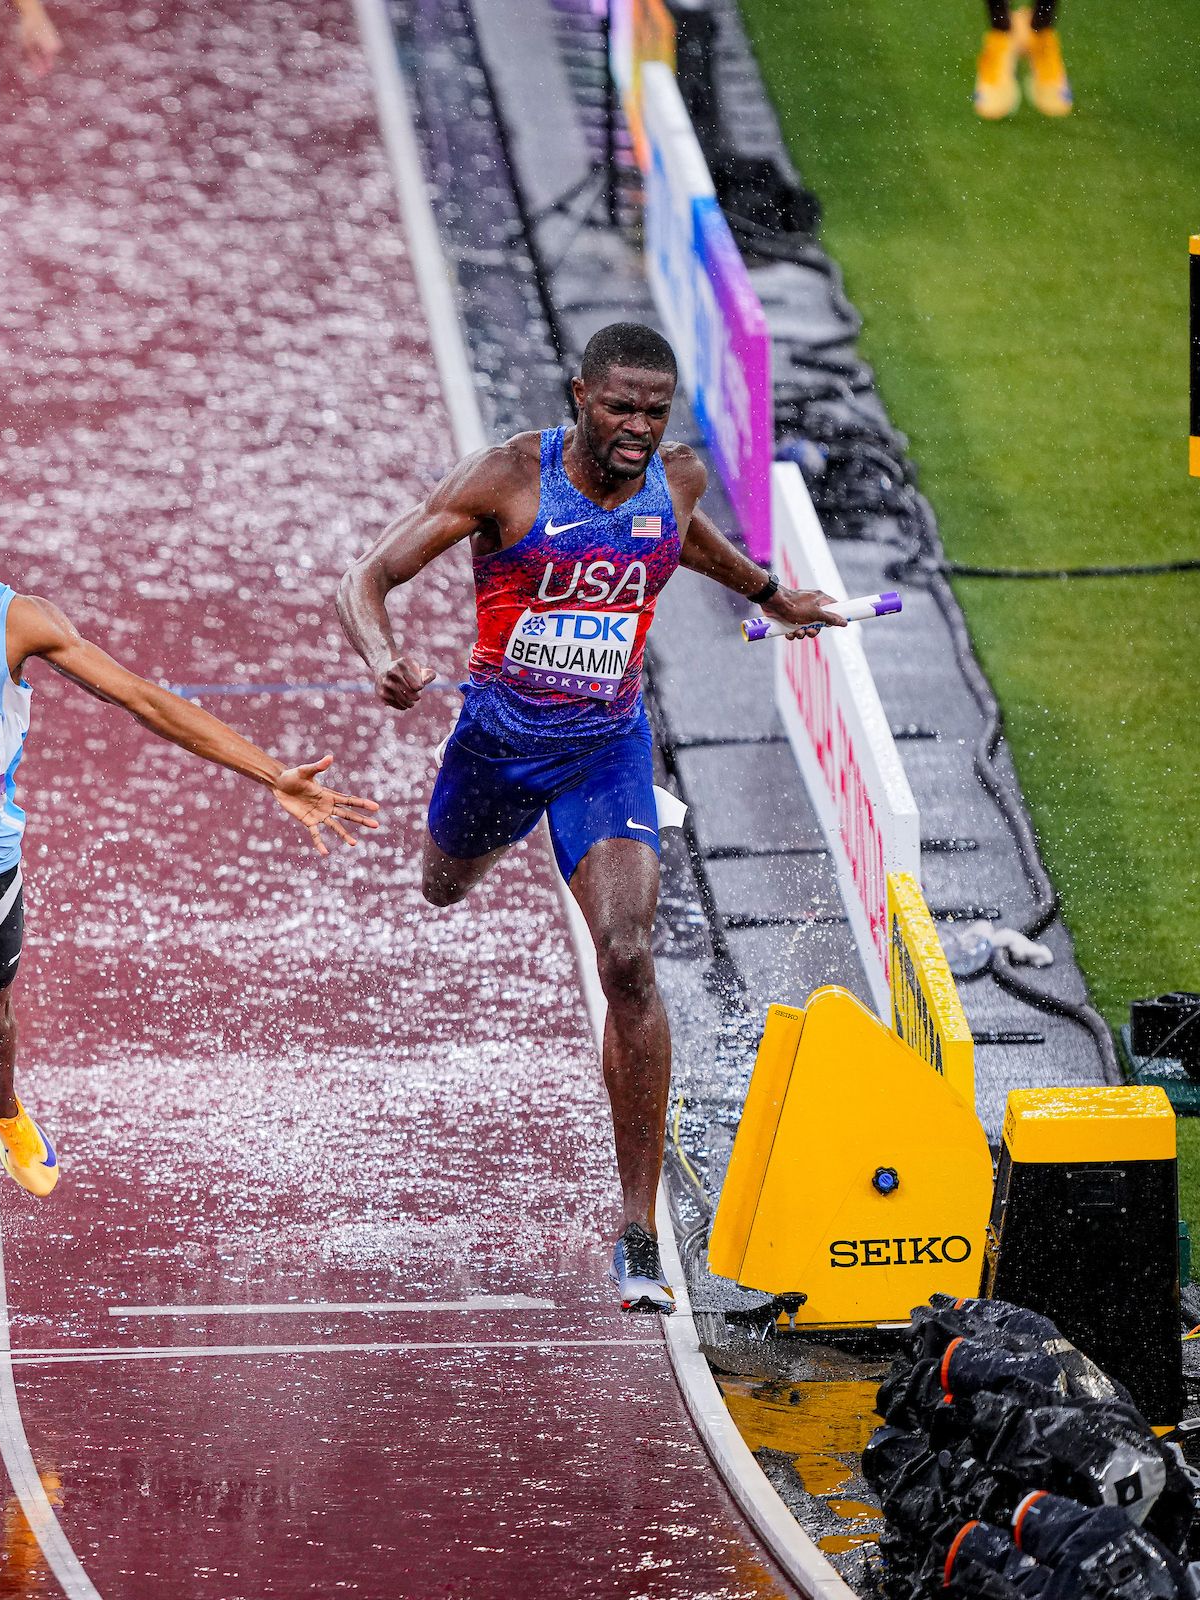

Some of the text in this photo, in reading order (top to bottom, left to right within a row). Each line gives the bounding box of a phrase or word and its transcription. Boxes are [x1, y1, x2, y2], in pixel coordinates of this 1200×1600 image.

[537, 561, 647, 606] USA
[548, 614, 630, 642] TDK
[511, 639, 628, 675] BENJAMIN
[774, 1009, 799, 1021] SEIKO
[829, 1235, 972, 1268] SEIKO
